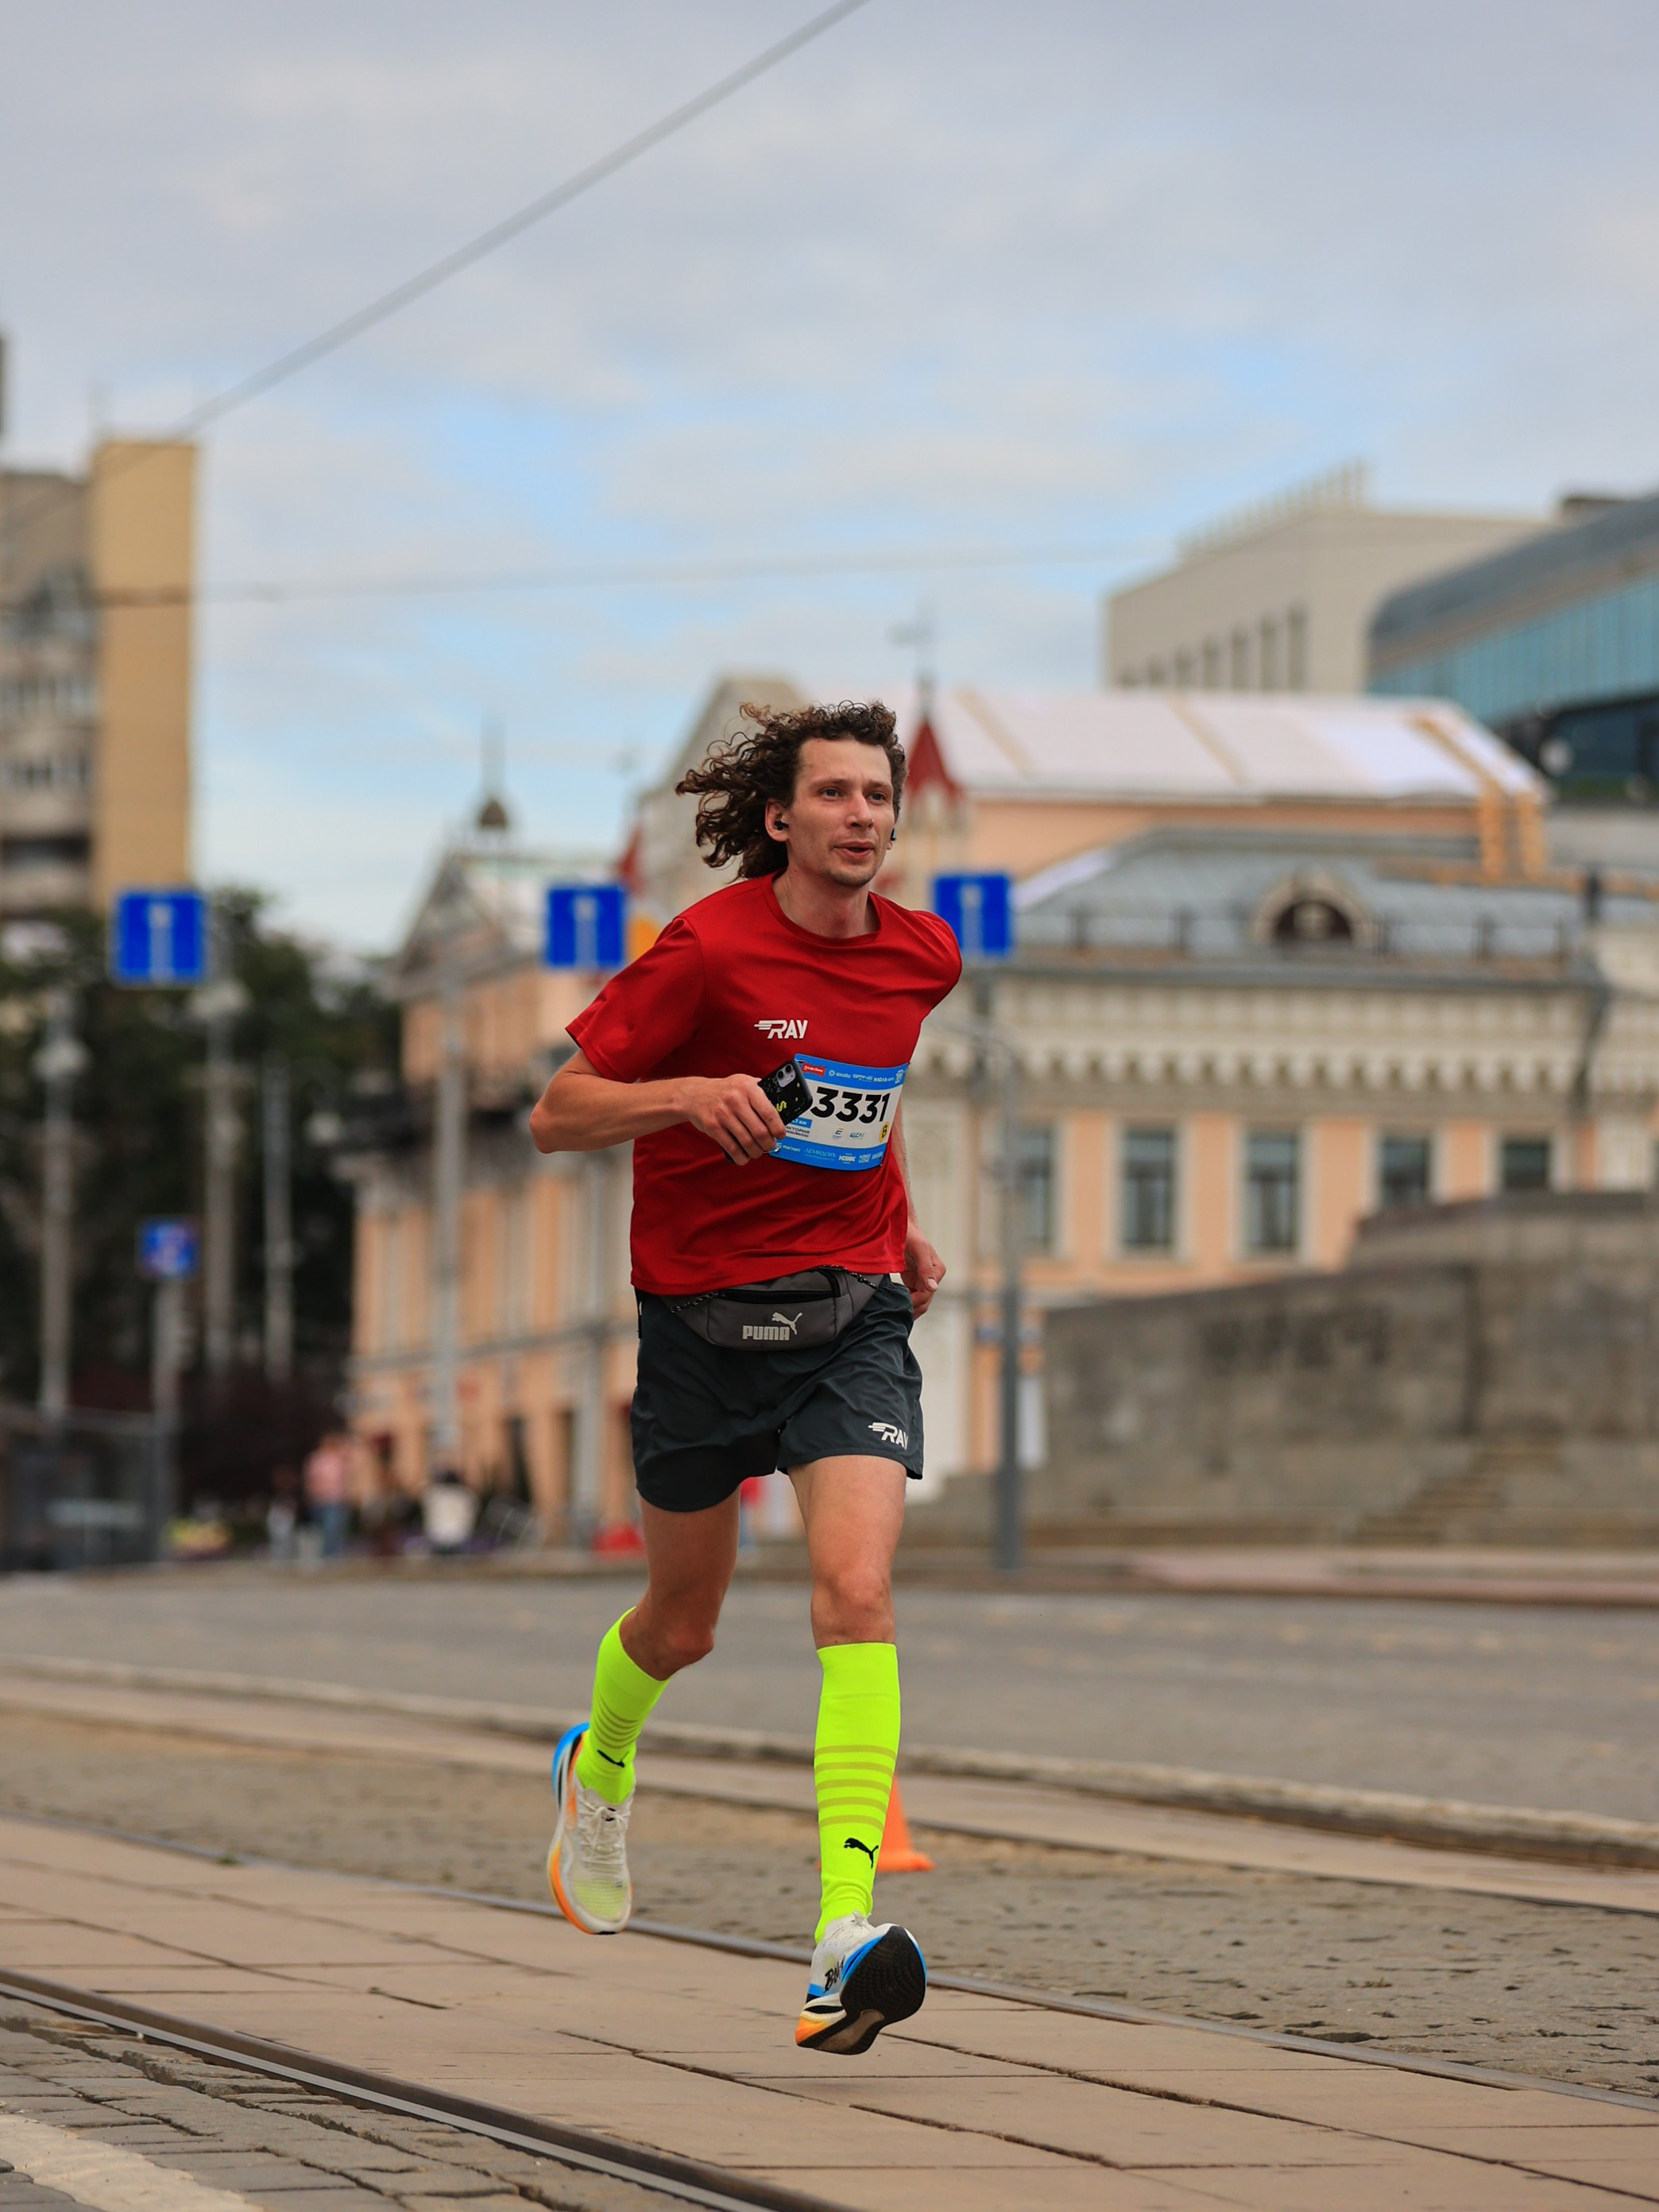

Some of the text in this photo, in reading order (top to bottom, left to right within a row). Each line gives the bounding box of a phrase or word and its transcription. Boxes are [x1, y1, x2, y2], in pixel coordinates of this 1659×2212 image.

[754, 1019, 808, 1039] RAY
[810, 1086, 891, 1124] 3331
[742, 1325, 790, 1340] PUMA
[868, 1422, 908, 1450] RAY
